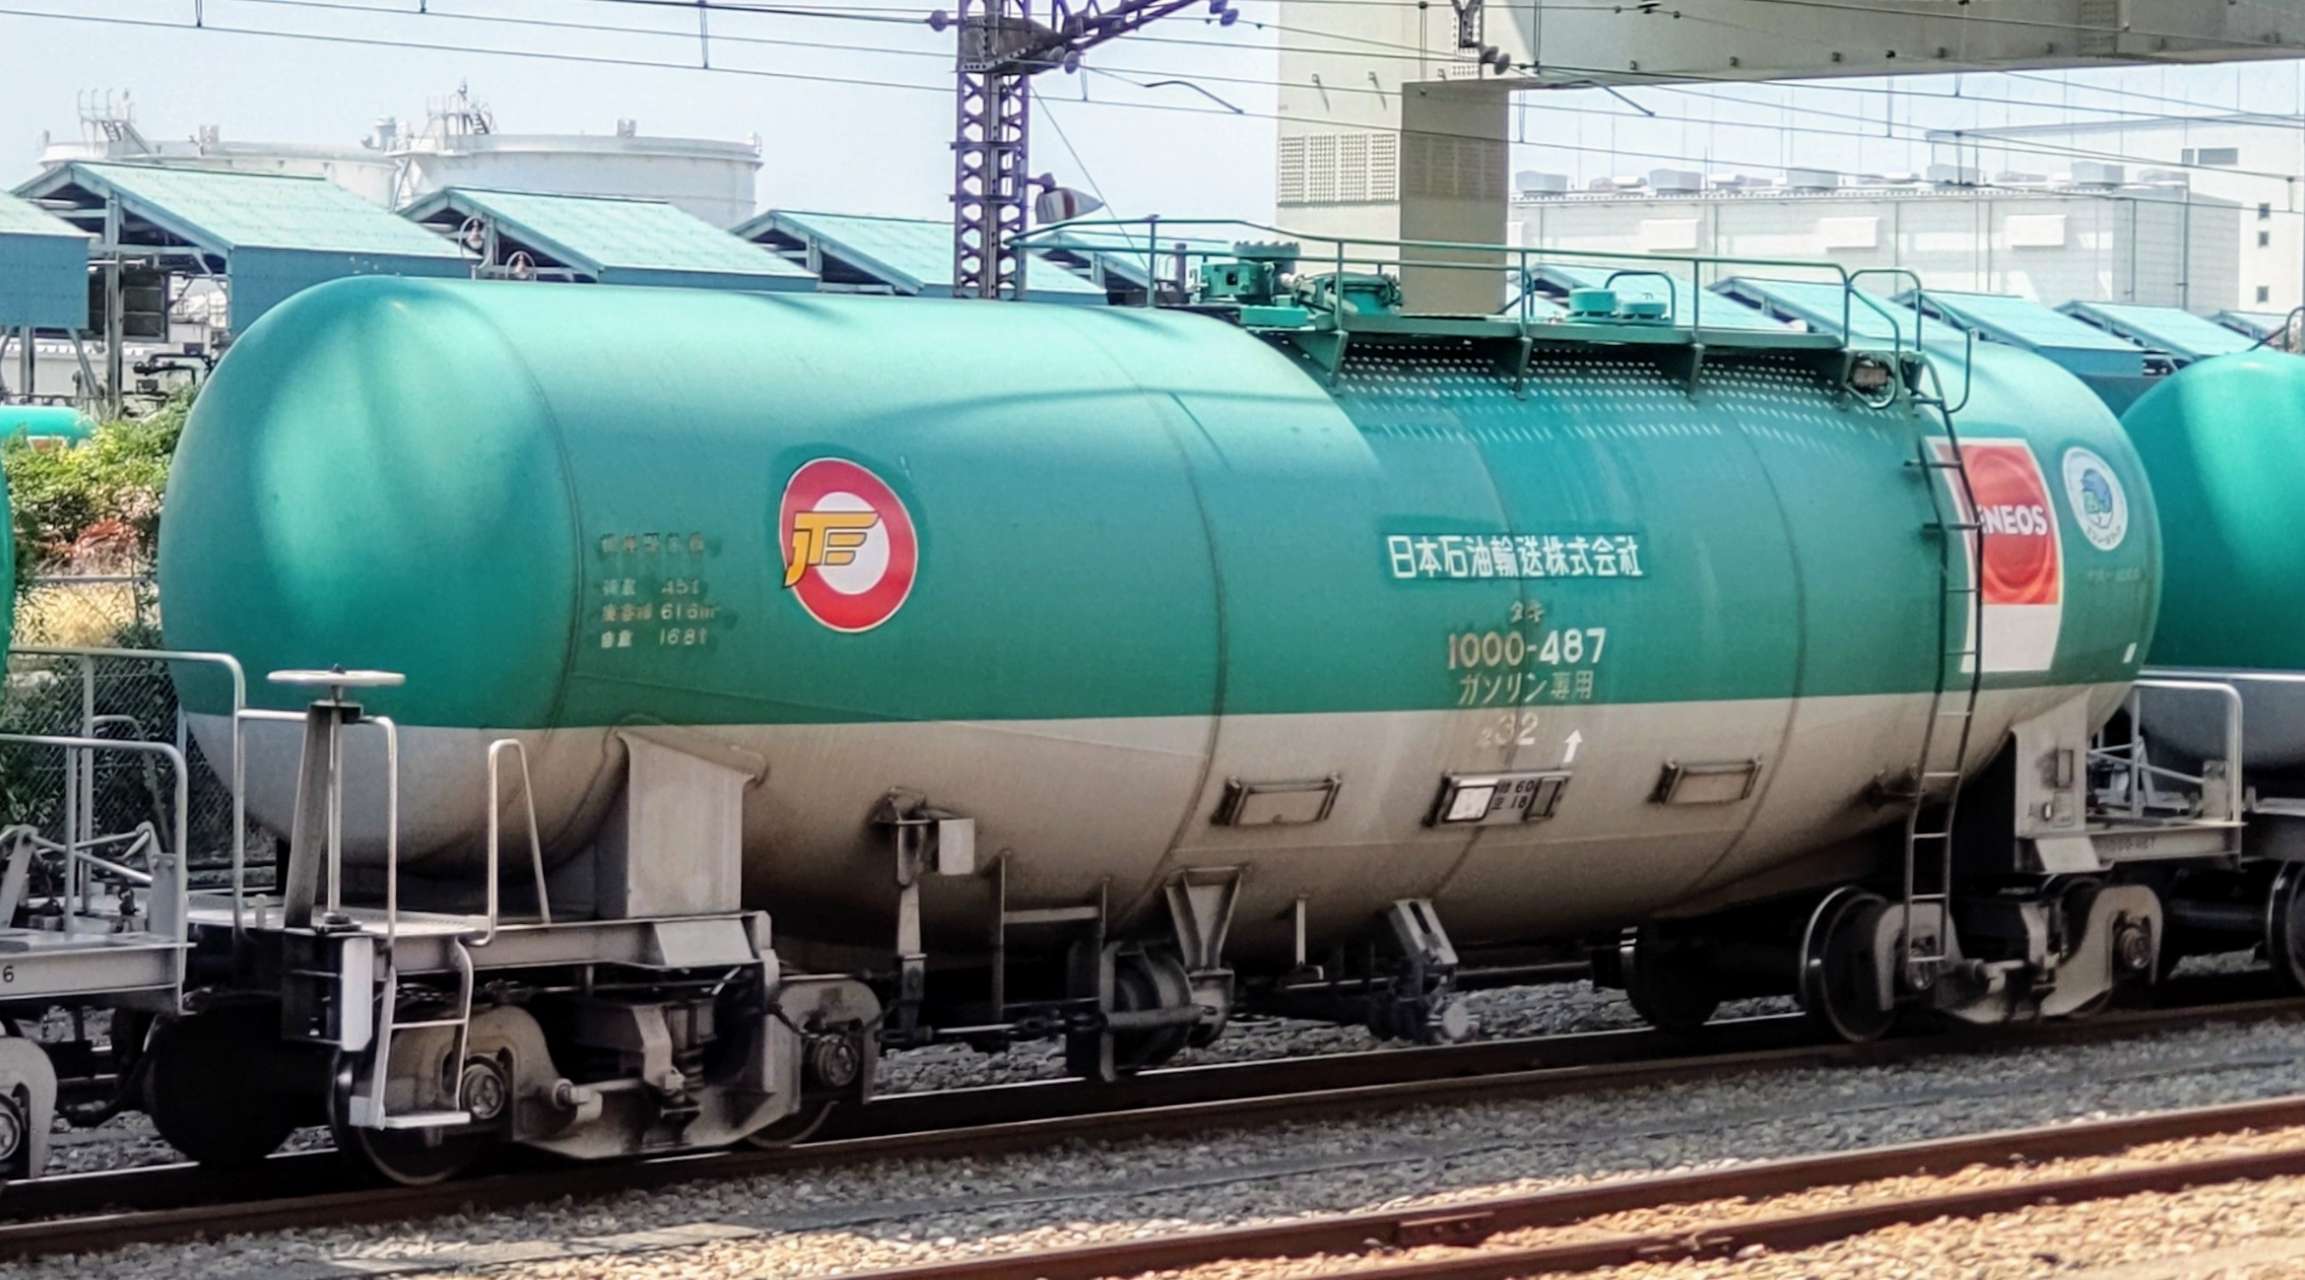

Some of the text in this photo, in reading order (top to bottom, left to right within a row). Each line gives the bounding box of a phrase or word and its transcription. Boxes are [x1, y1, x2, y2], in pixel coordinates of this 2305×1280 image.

[1388, 535, 1643, 578] 日本石油輸送株式会社
[1448, 627, 1607, 669] 1000-487
[1458, 670, 1595, 705] ガソリン専用
[2, 964, 15, 983] 6
